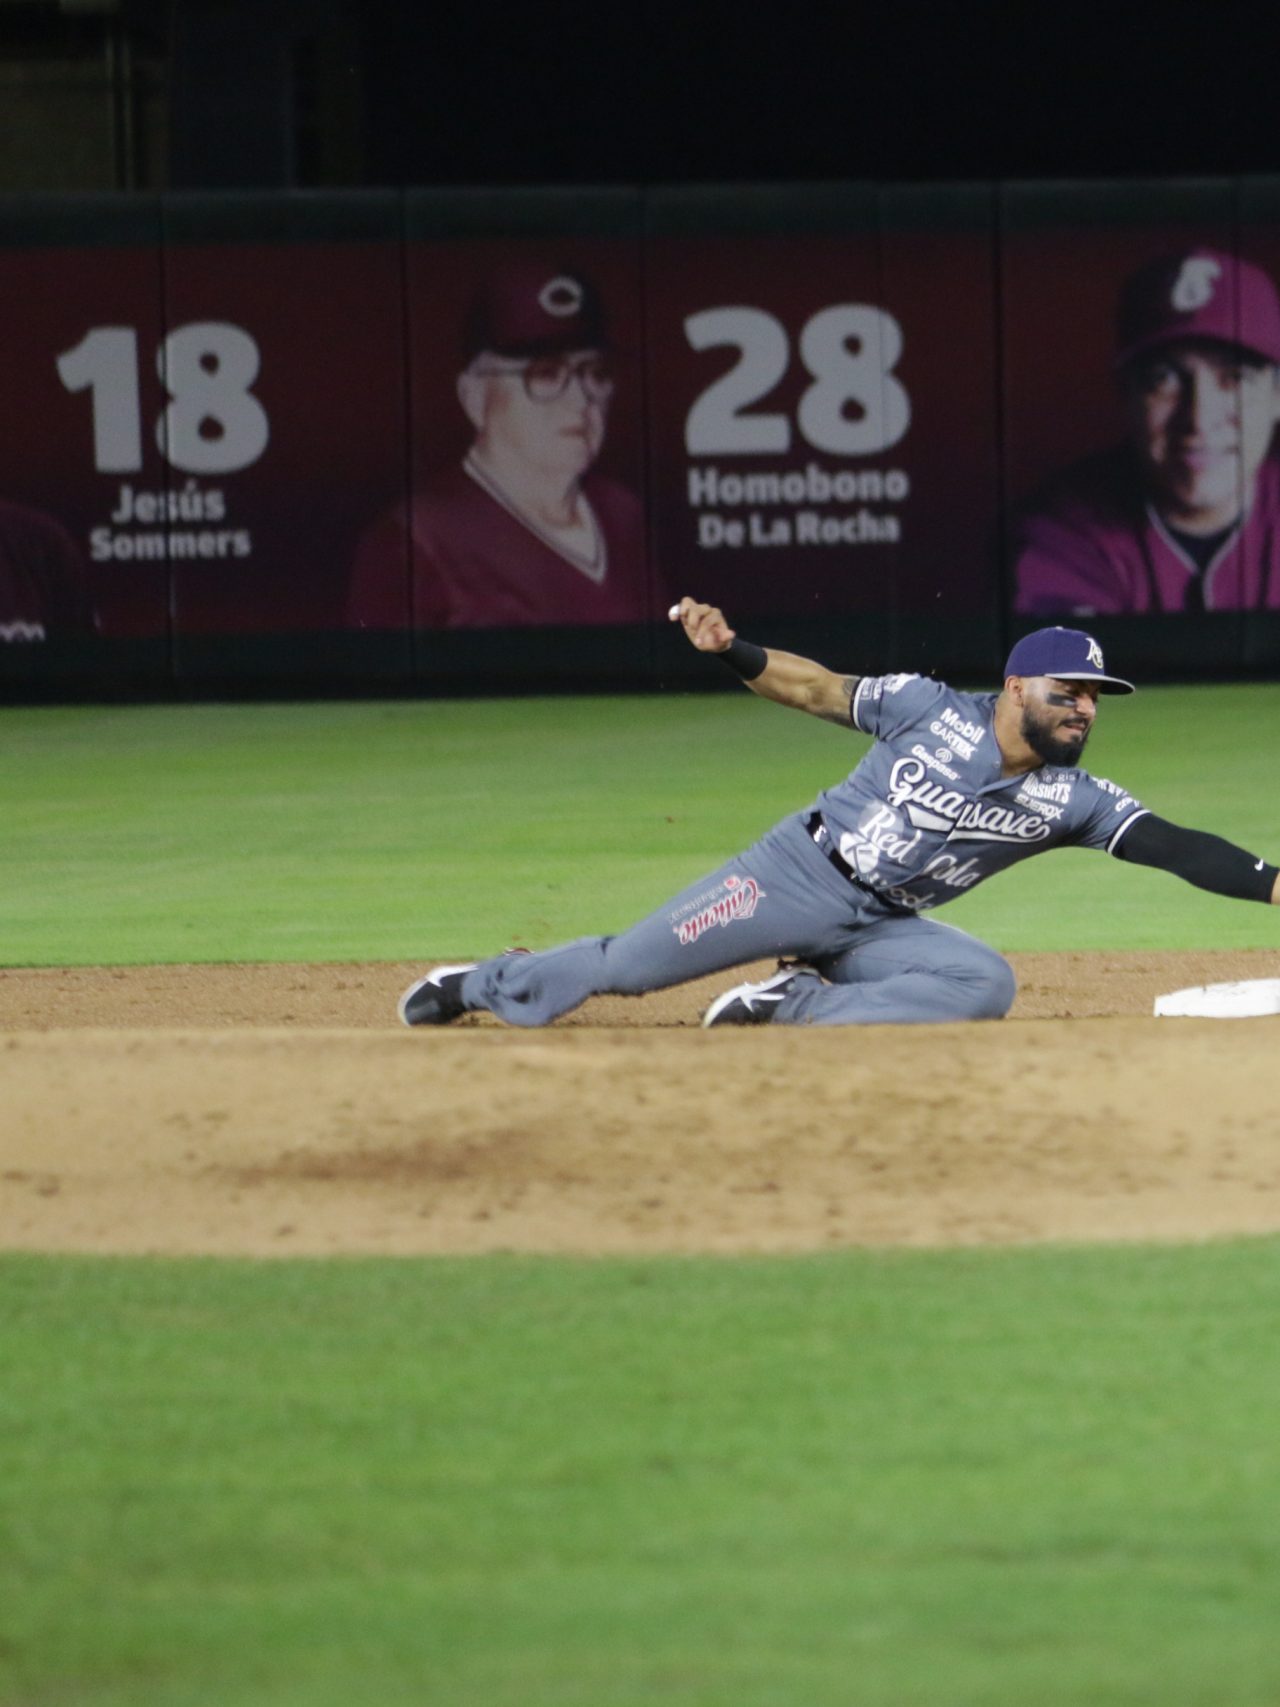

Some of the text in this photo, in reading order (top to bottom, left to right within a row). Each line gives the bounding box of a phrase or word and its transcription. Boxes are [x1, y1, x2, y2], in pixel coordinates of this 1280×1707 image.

[56, 321, 270, 476] 18
[684, 302, 911, 456] 28
[111, 479, 225, 524] Jesús
[687, 464, 909, 506] Homobono
[90, 527, 250, 561] Sommers
[698, 509, 900, 547] De La Rocha
[940, 707, 986, 745] Mobil
[887, 757, 1051, 843] Guasave
[859, 804, 923, 864] Red
